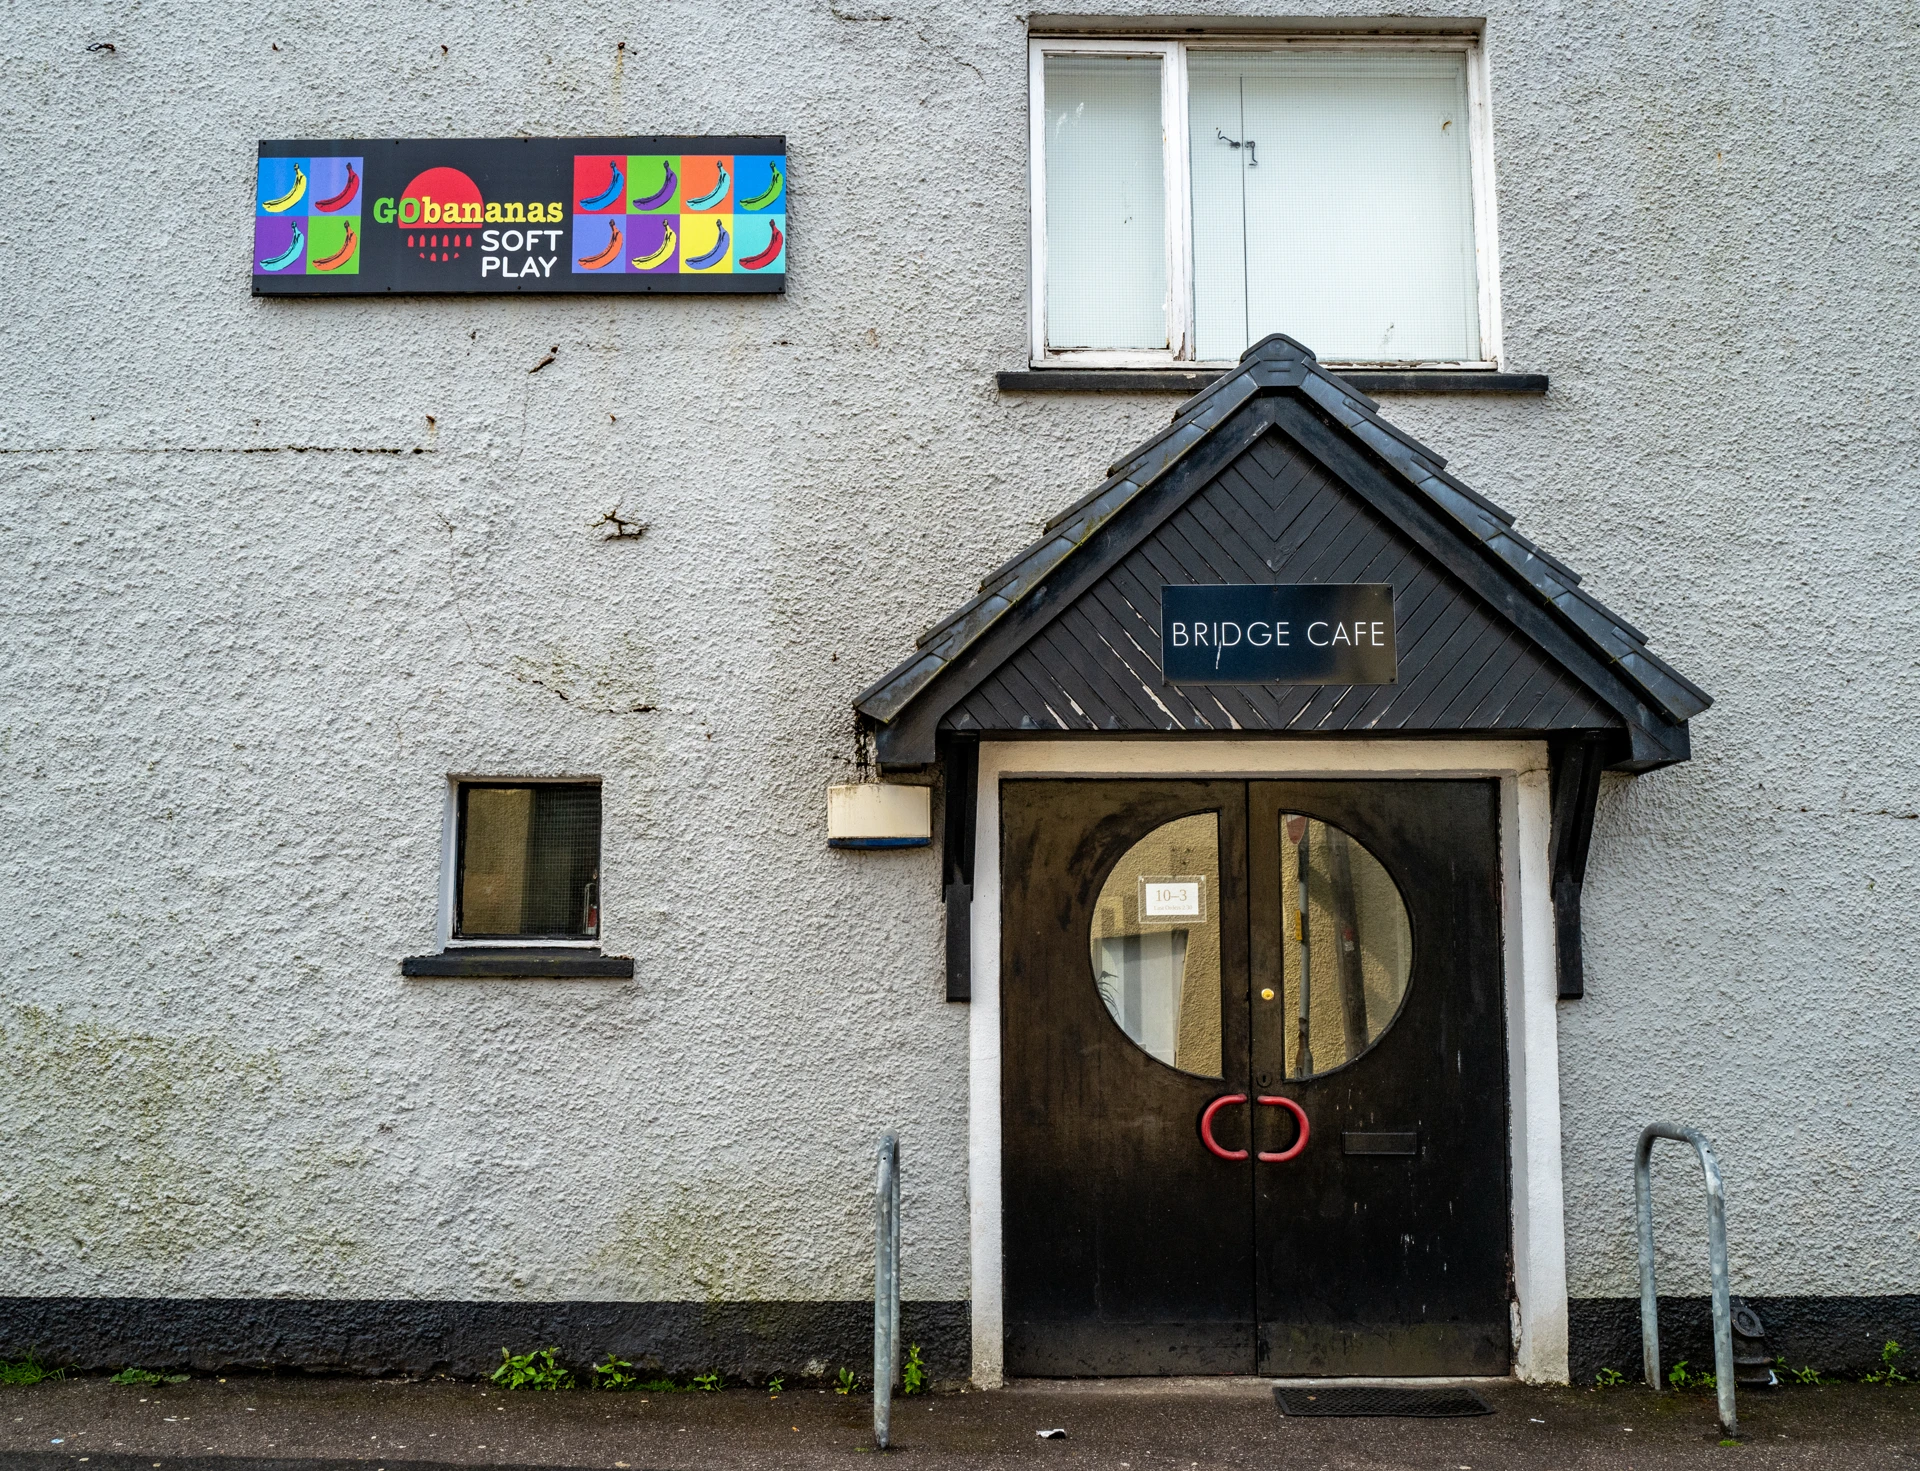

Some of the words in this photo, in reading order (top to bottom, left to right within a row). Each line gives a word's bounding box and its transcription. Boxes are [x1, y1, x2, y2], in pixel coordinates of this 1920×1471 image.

[481, 230, 564, 252] SOFT
[481, 256, 558, 278] PLAY
[1172, 621, 1290, 647] BRIDGE
[1307, 621, 1385, 647] CAFE
